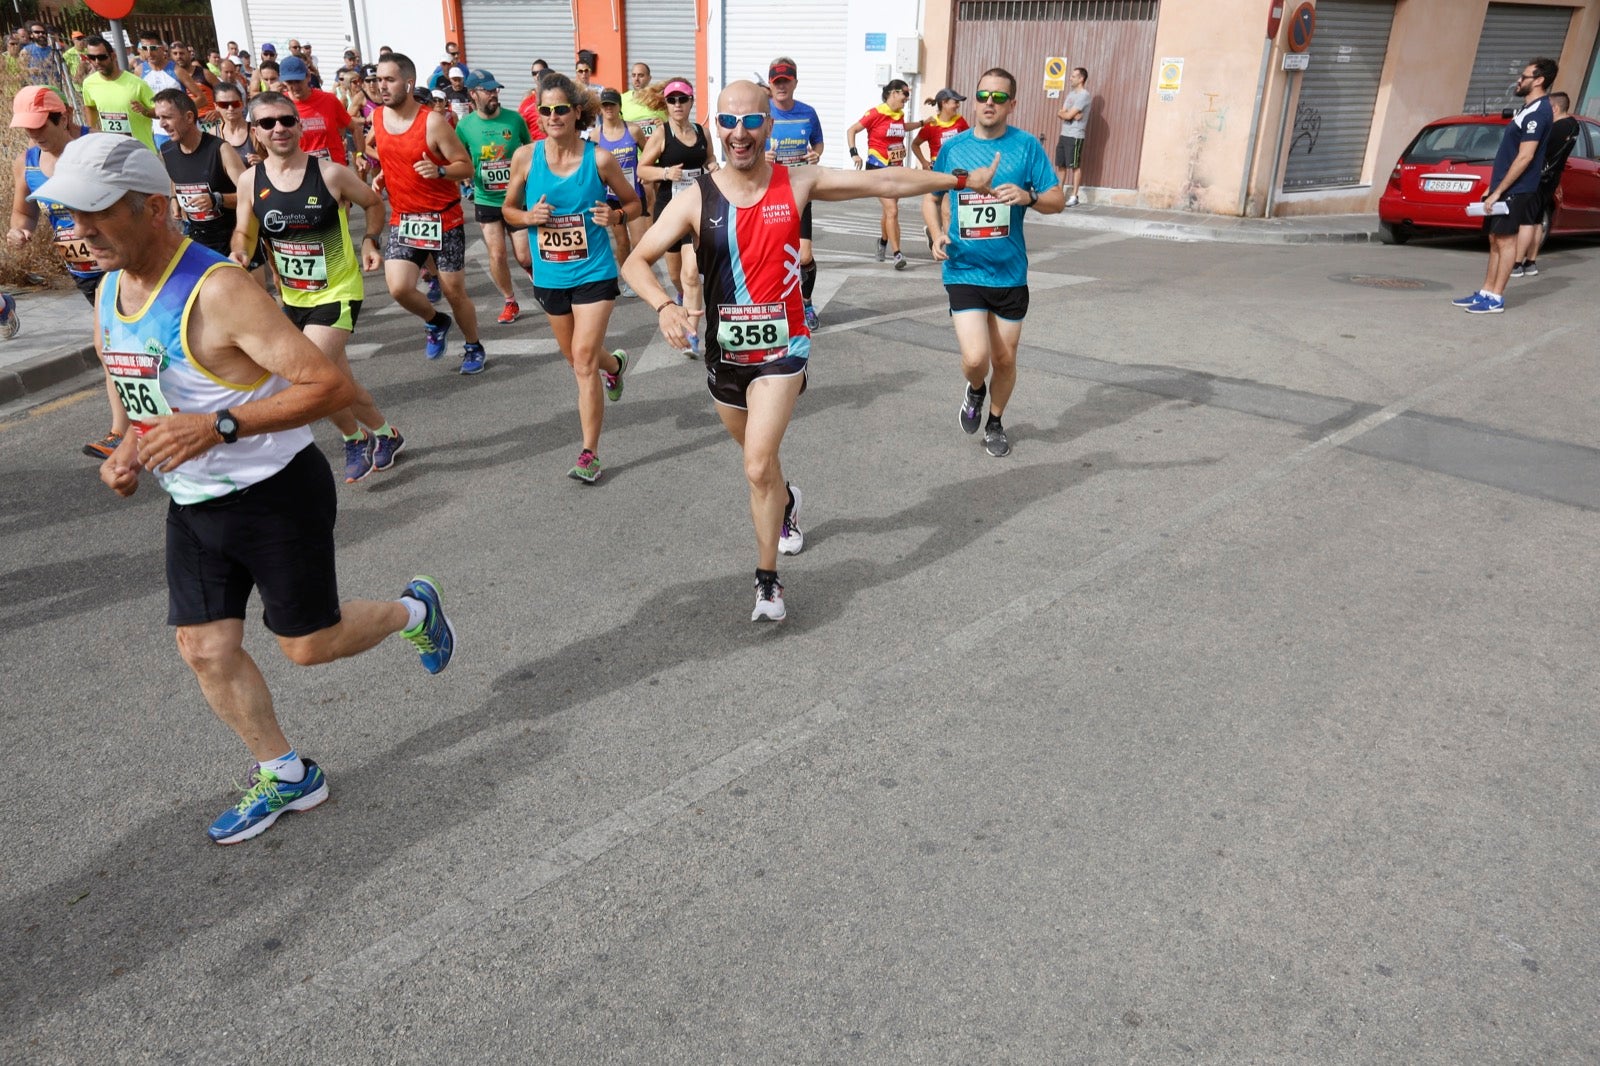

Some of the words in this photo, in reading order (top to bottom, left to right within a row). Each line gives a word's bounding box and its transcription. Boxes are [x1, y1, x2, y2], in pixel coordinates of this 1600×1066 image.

[109, 121, 122, 131] 23
[488, 169, 510, 182] 900
[1430, 181, 1451, 190] 2669
[1453, 181, 1470, 190] FNJ
[762, 204, 790, 212] SAPIENS
[763, 210, 791, 218] HUMAN
[764, 217, 792, 225] RUNNER
[973, 207, 996, 224] 79
[403, 222, 438, 237] 1021
[543, 231, 584, 247] 2053
[281, 257, 316, 276] 737
[729, 324, 778, 346] 358
[114, 380, 158, 415] 856
